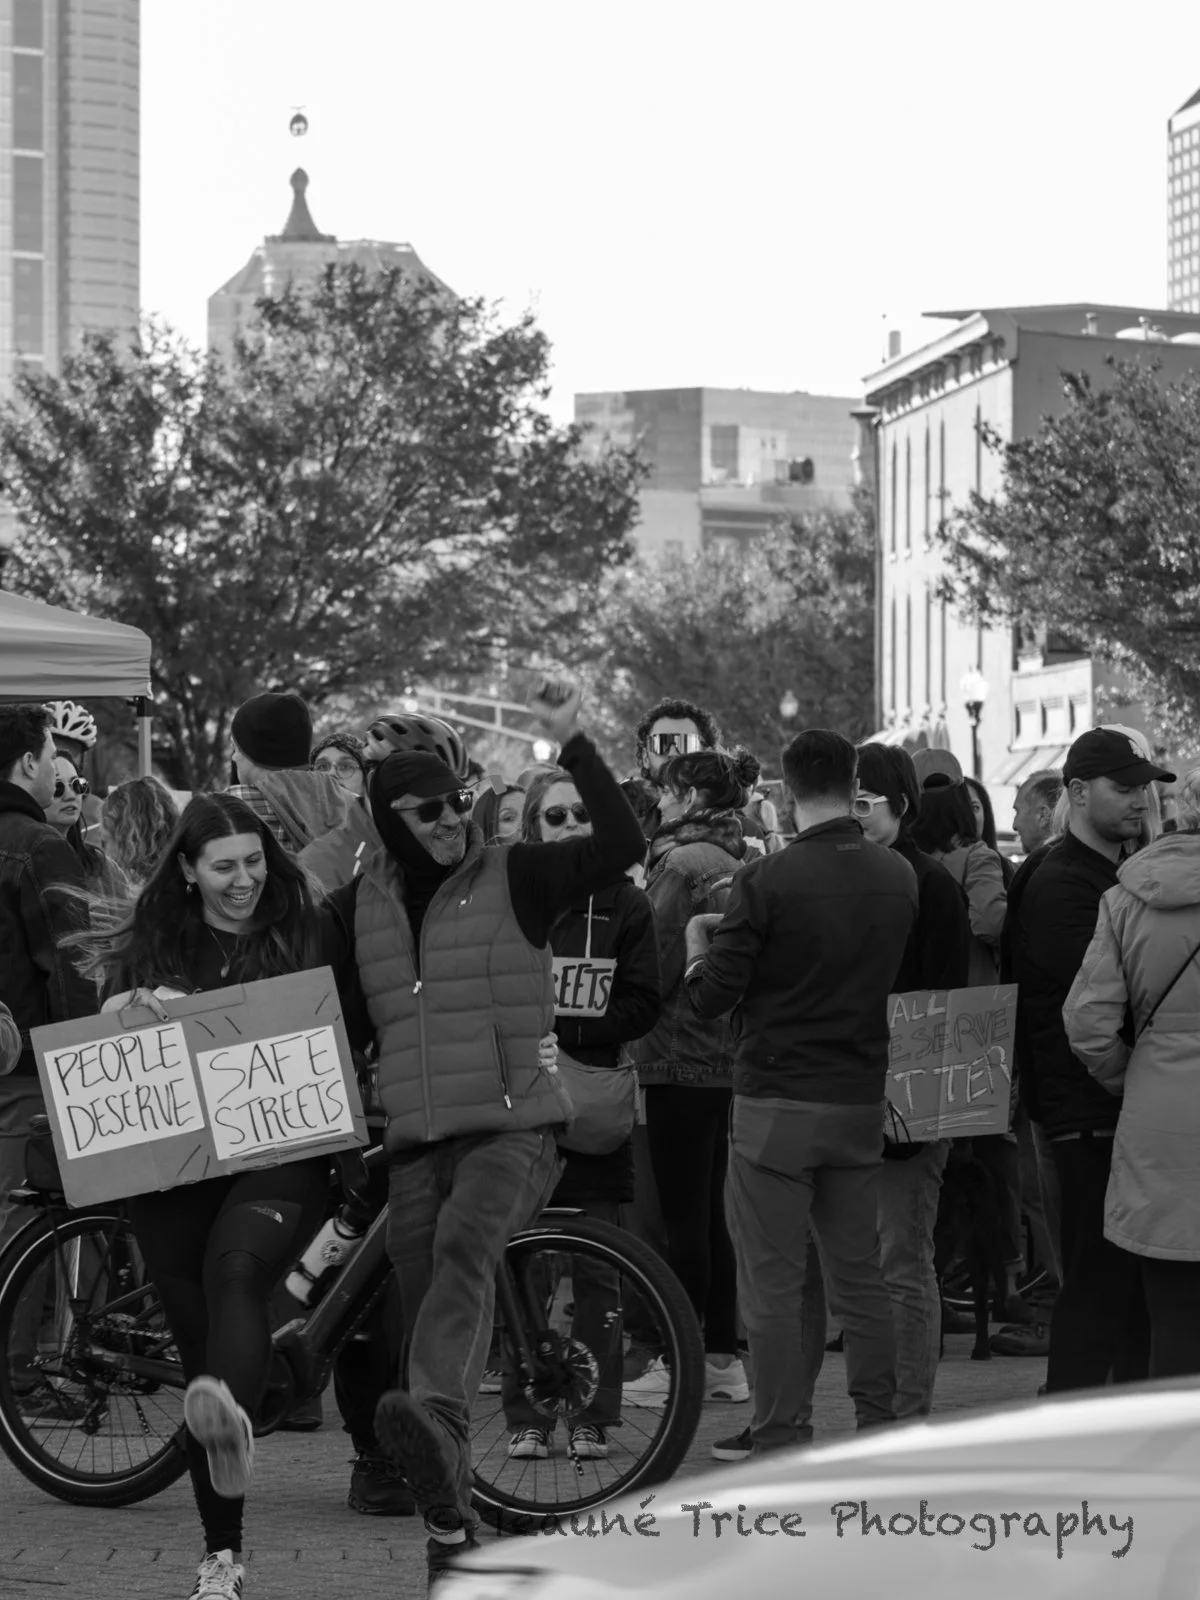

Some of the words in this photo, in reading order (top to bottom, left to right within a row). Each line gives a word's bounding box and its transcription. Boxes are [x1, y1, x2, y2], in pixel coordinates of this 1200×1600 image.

[889, 994, 945, 1028] ALL
[889, 1007, 1010, 1065] ESERVE
[54, 1027, 182, 1096] PEOPLE
[209, 1028, 337, 1103] SAFE
[888, 1046, 1010, 1114] TTER
[67, 1078, 195, 1152] DESERVE
[215, 1080, 344, 1145] STREETS
